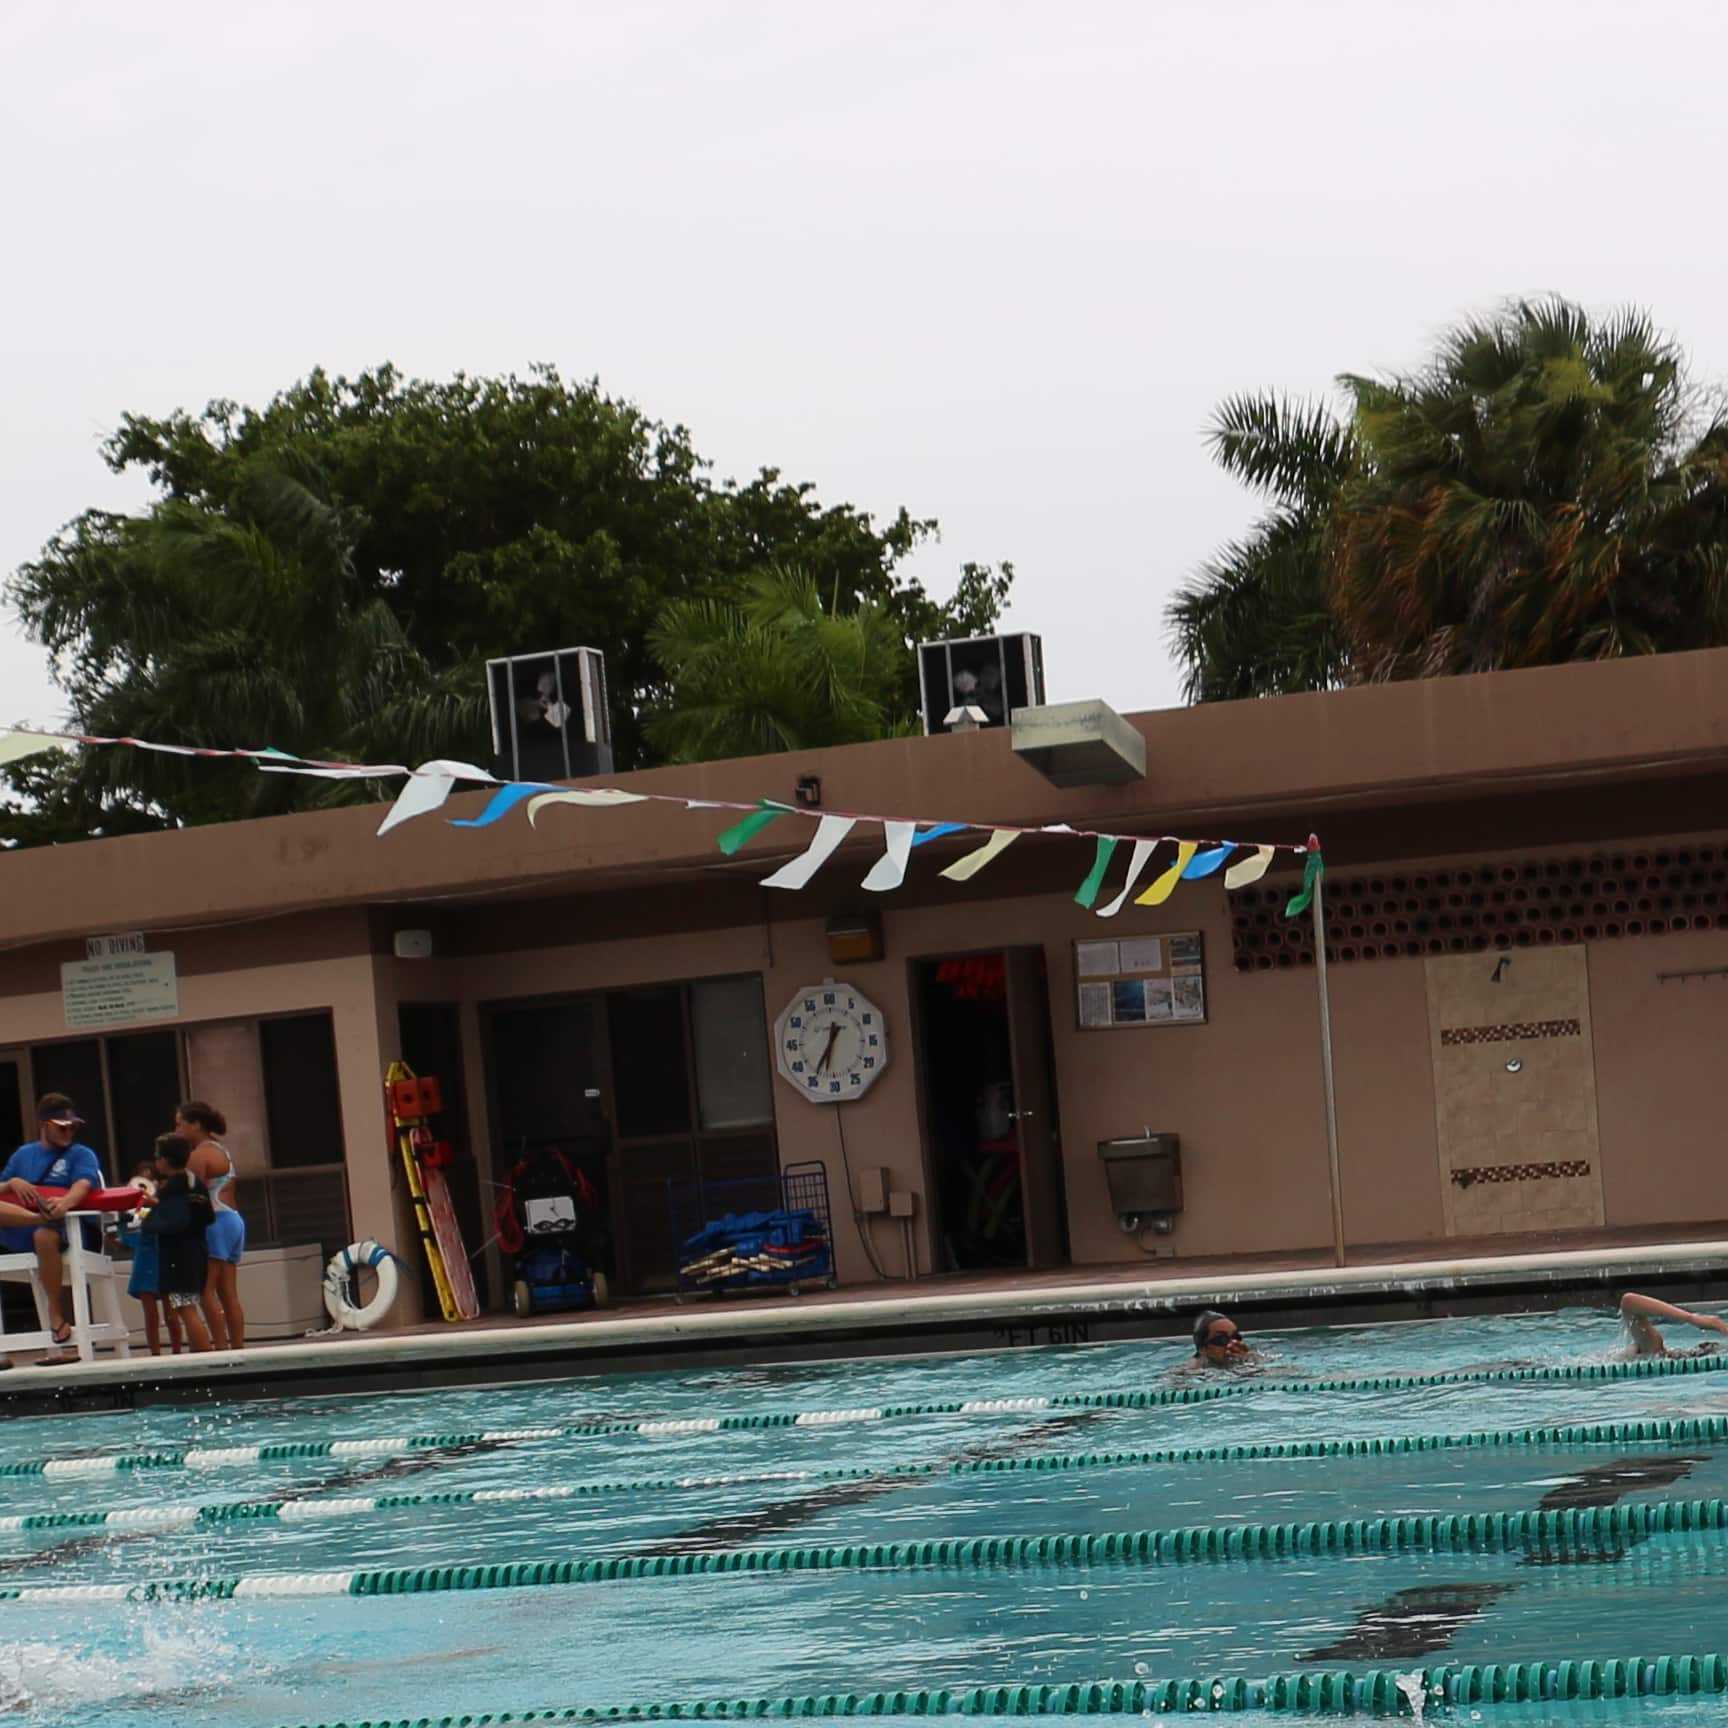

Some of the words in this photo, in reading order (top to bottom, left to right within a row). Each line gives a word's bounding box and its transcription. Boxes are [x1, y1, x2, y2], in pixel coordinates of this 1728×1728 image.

[88, 938, 103, 956] NO
[108, 933, 144, 953] DIVING
[824, 992, 835, 1005] 60
[848, 997, 855, 1009] 5
[790, 1016, 801, 1028] 50
[786, 1039, 798, 1051] 45
[868, 1034, 878, 1046] 15
[791, 1060, 804, 1073] 40
[863, 1056, 874, 1068] 20
[807, 1075, 819, 1087] 35
[850, 1072, 861, 1085] 25
[830, 1080, 841, 1092] 30
